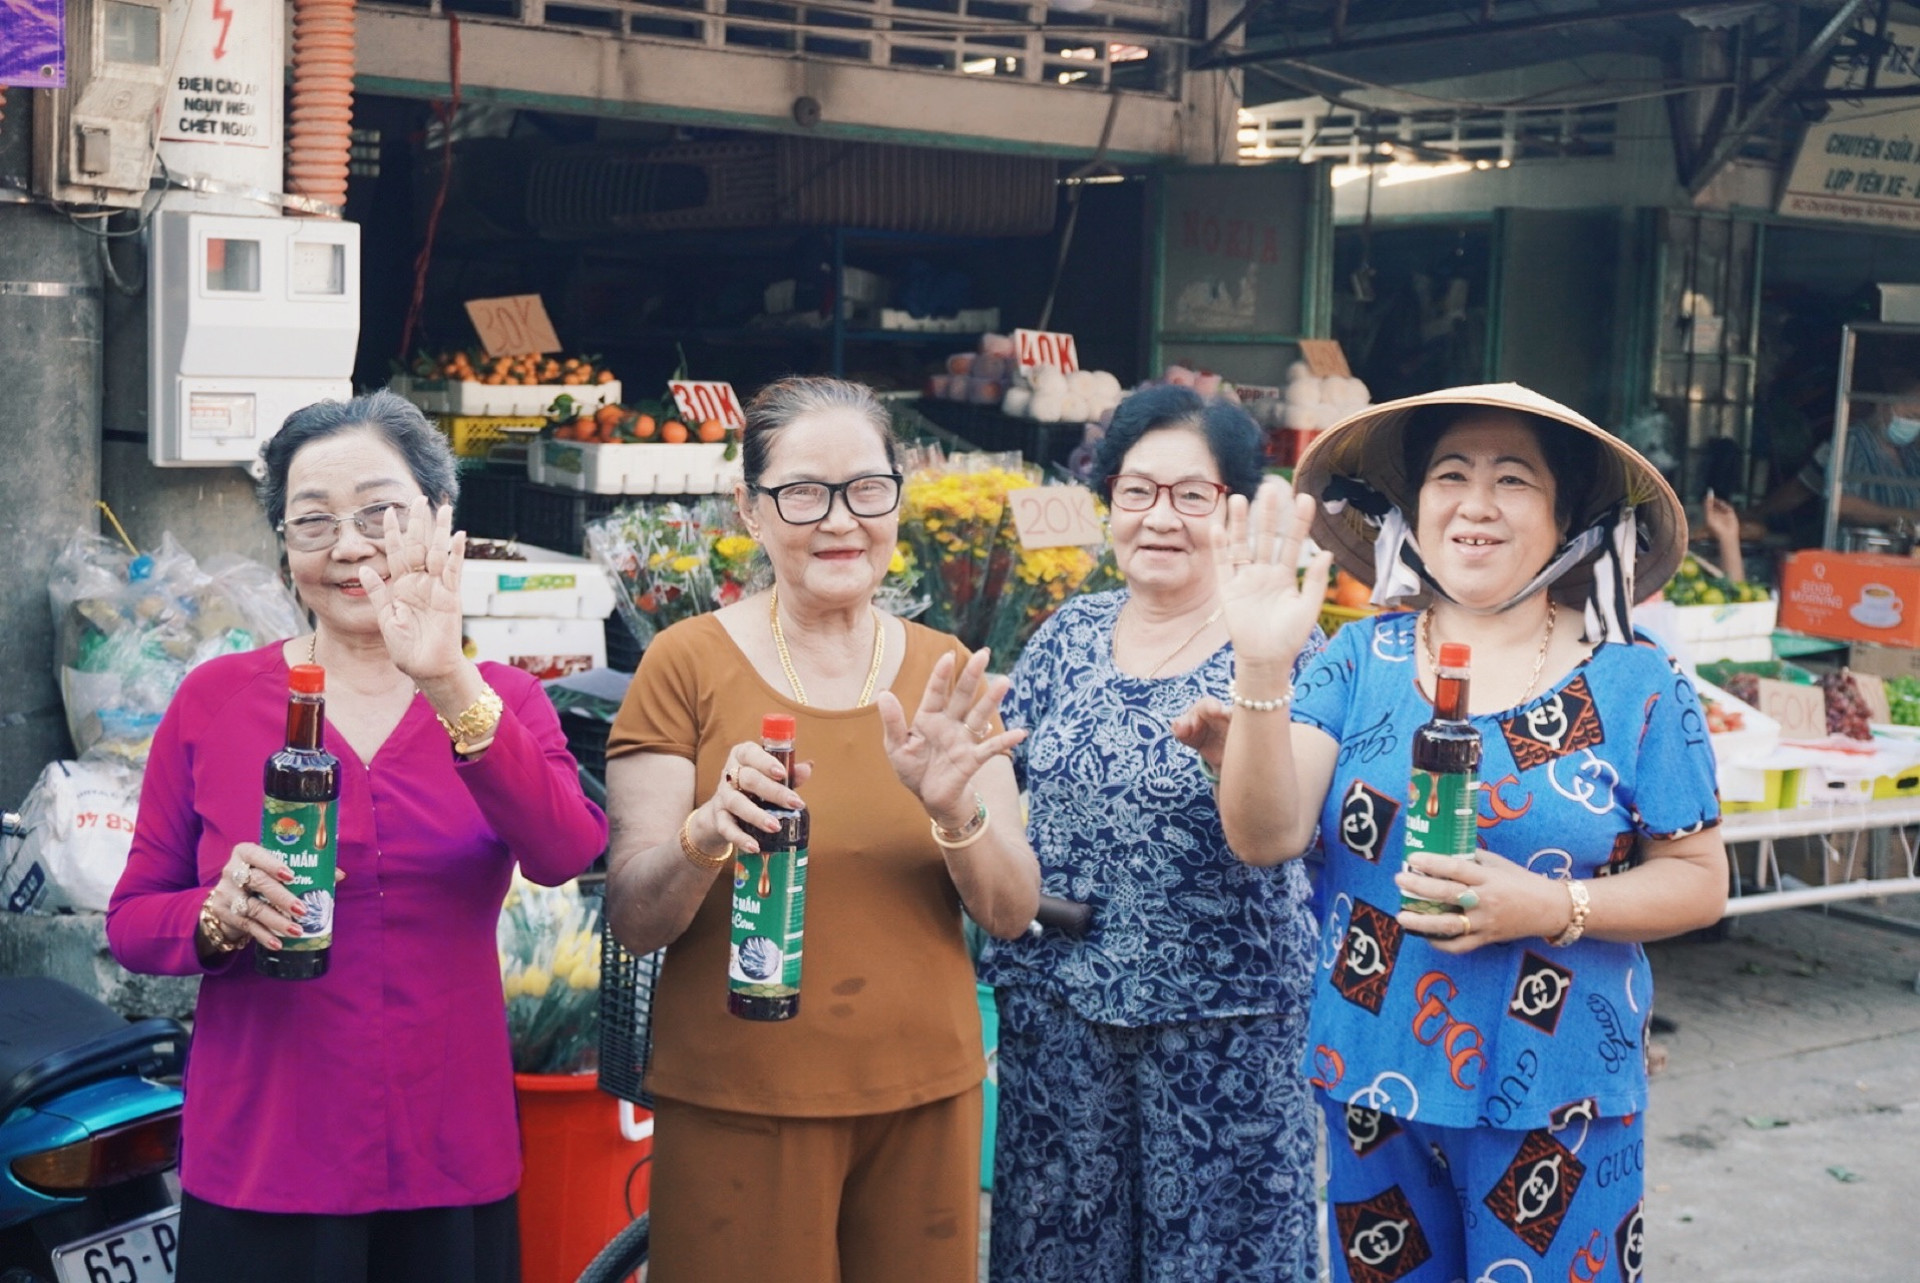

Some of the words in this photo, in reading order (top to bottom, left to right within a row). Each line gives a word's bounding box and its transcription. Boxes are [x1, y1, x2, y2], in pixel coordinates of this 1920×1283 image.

[184, 97, 223, 114] NGUY
[215, 78, 242, 95] CAO
[1021, 333, 1076, 375] 40K
[673, 383, 744, 429] 30K
[1020, 496, 1099, 534] 20K
